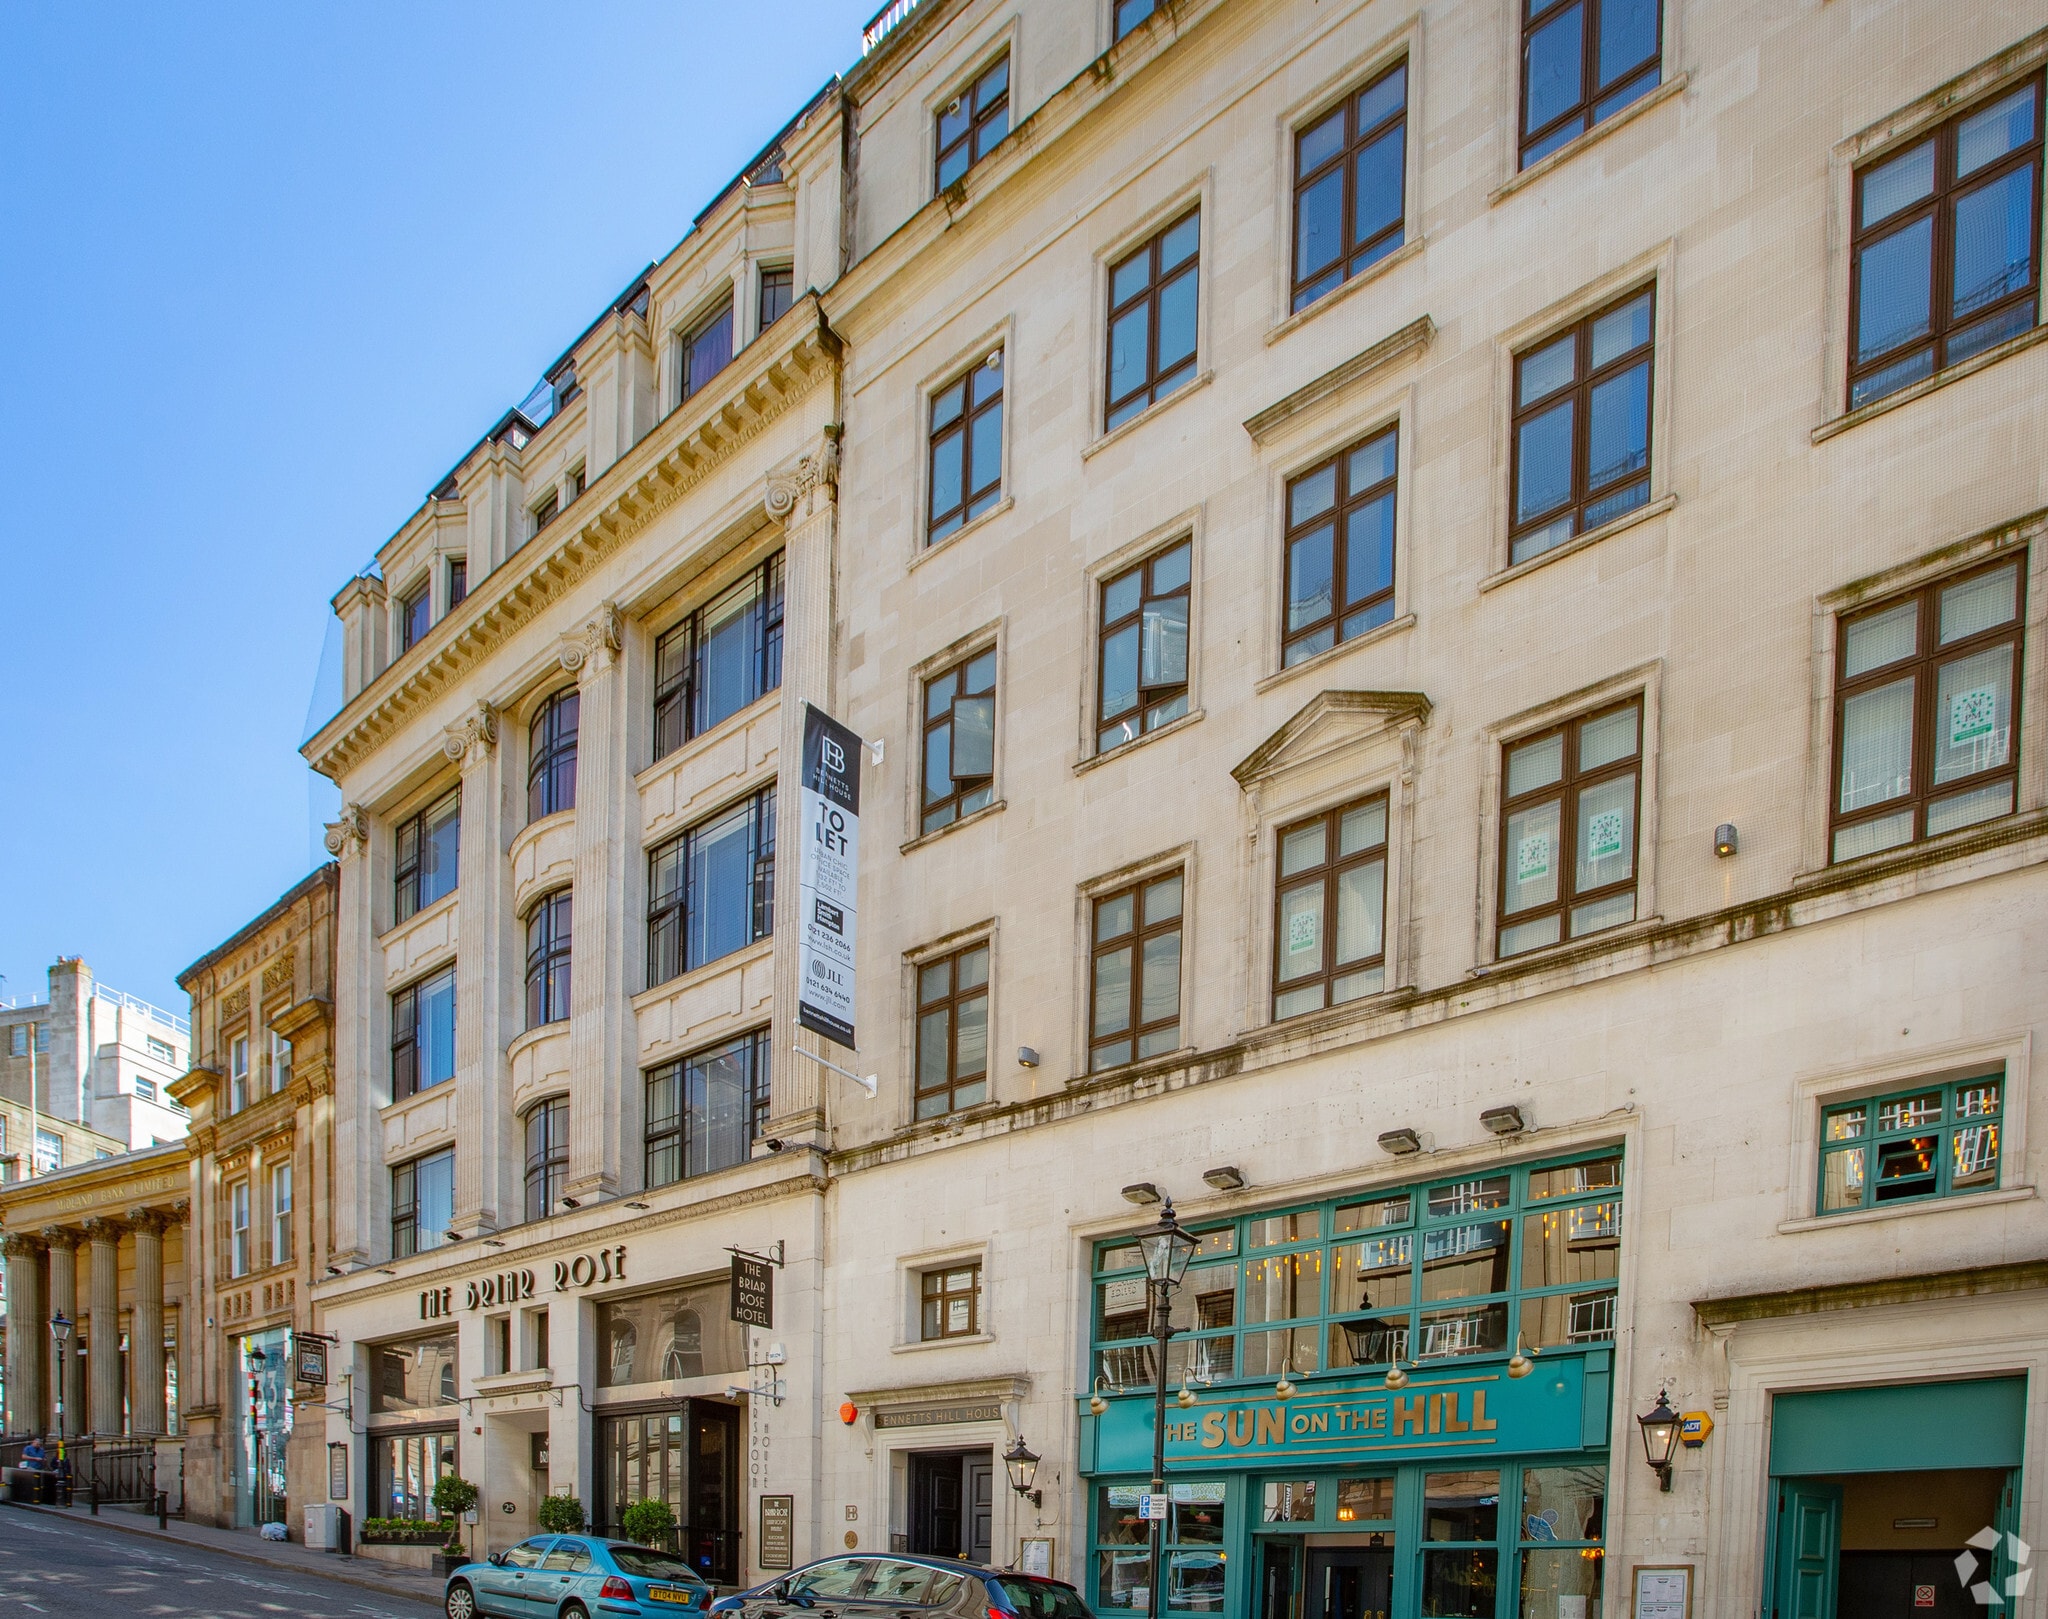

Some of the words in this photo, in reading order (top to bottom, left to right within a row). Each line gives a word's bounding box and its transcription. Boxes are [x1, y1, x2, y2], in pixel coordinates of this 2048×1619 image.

[829, 782, 852, 801] HOUSE
[819, 801, 845, 833] TO
[816, 822, 848, 857] LET
[833, 858, 849, 872] CHIC
[833, 864, 850, 880] SPACE
[826, 968, 843, 986] JLL
[56, 1193, 94, 1211] MIDLAND
[101, 1186, 125, 1202] BANK
[133, 1175, 175, 1195] LIMITED
[744, 1262, 761, 1277] THE
[418, 1286, 452, 1320] THE
[466, 1268, 535, 1311] BRIAR
[553, 1245, 627, 1292] ROSE
[738, 1276, 766, 1293] BRIAR
[740, 1292, 765, 1309] ROSE
[736, 1307, 768, 1325] HOTEL
[877, 1412, 932, 1426] BENNETTS
[936, 1410, 961, 1423] HILL
[966, 1407, 999, 1419] HOUS
[1163, 1421, 1196, 1442] HE
[1201, 1406, 1287, 1449] SUN
[1291, 1412, 1329, 1434] ON
[1336, 1408, 1388, 1431] THE
[1392, 1389, 1497, 1437] HILL
[1684, 1422, 1700, 1431] ADT
[503, 1503, 516, 1513] 25
[1143, 1496, 1149, 1506] P
[653, 1590, 671, 1599] BT04
[673, 1593, 686, 1601] NVU
